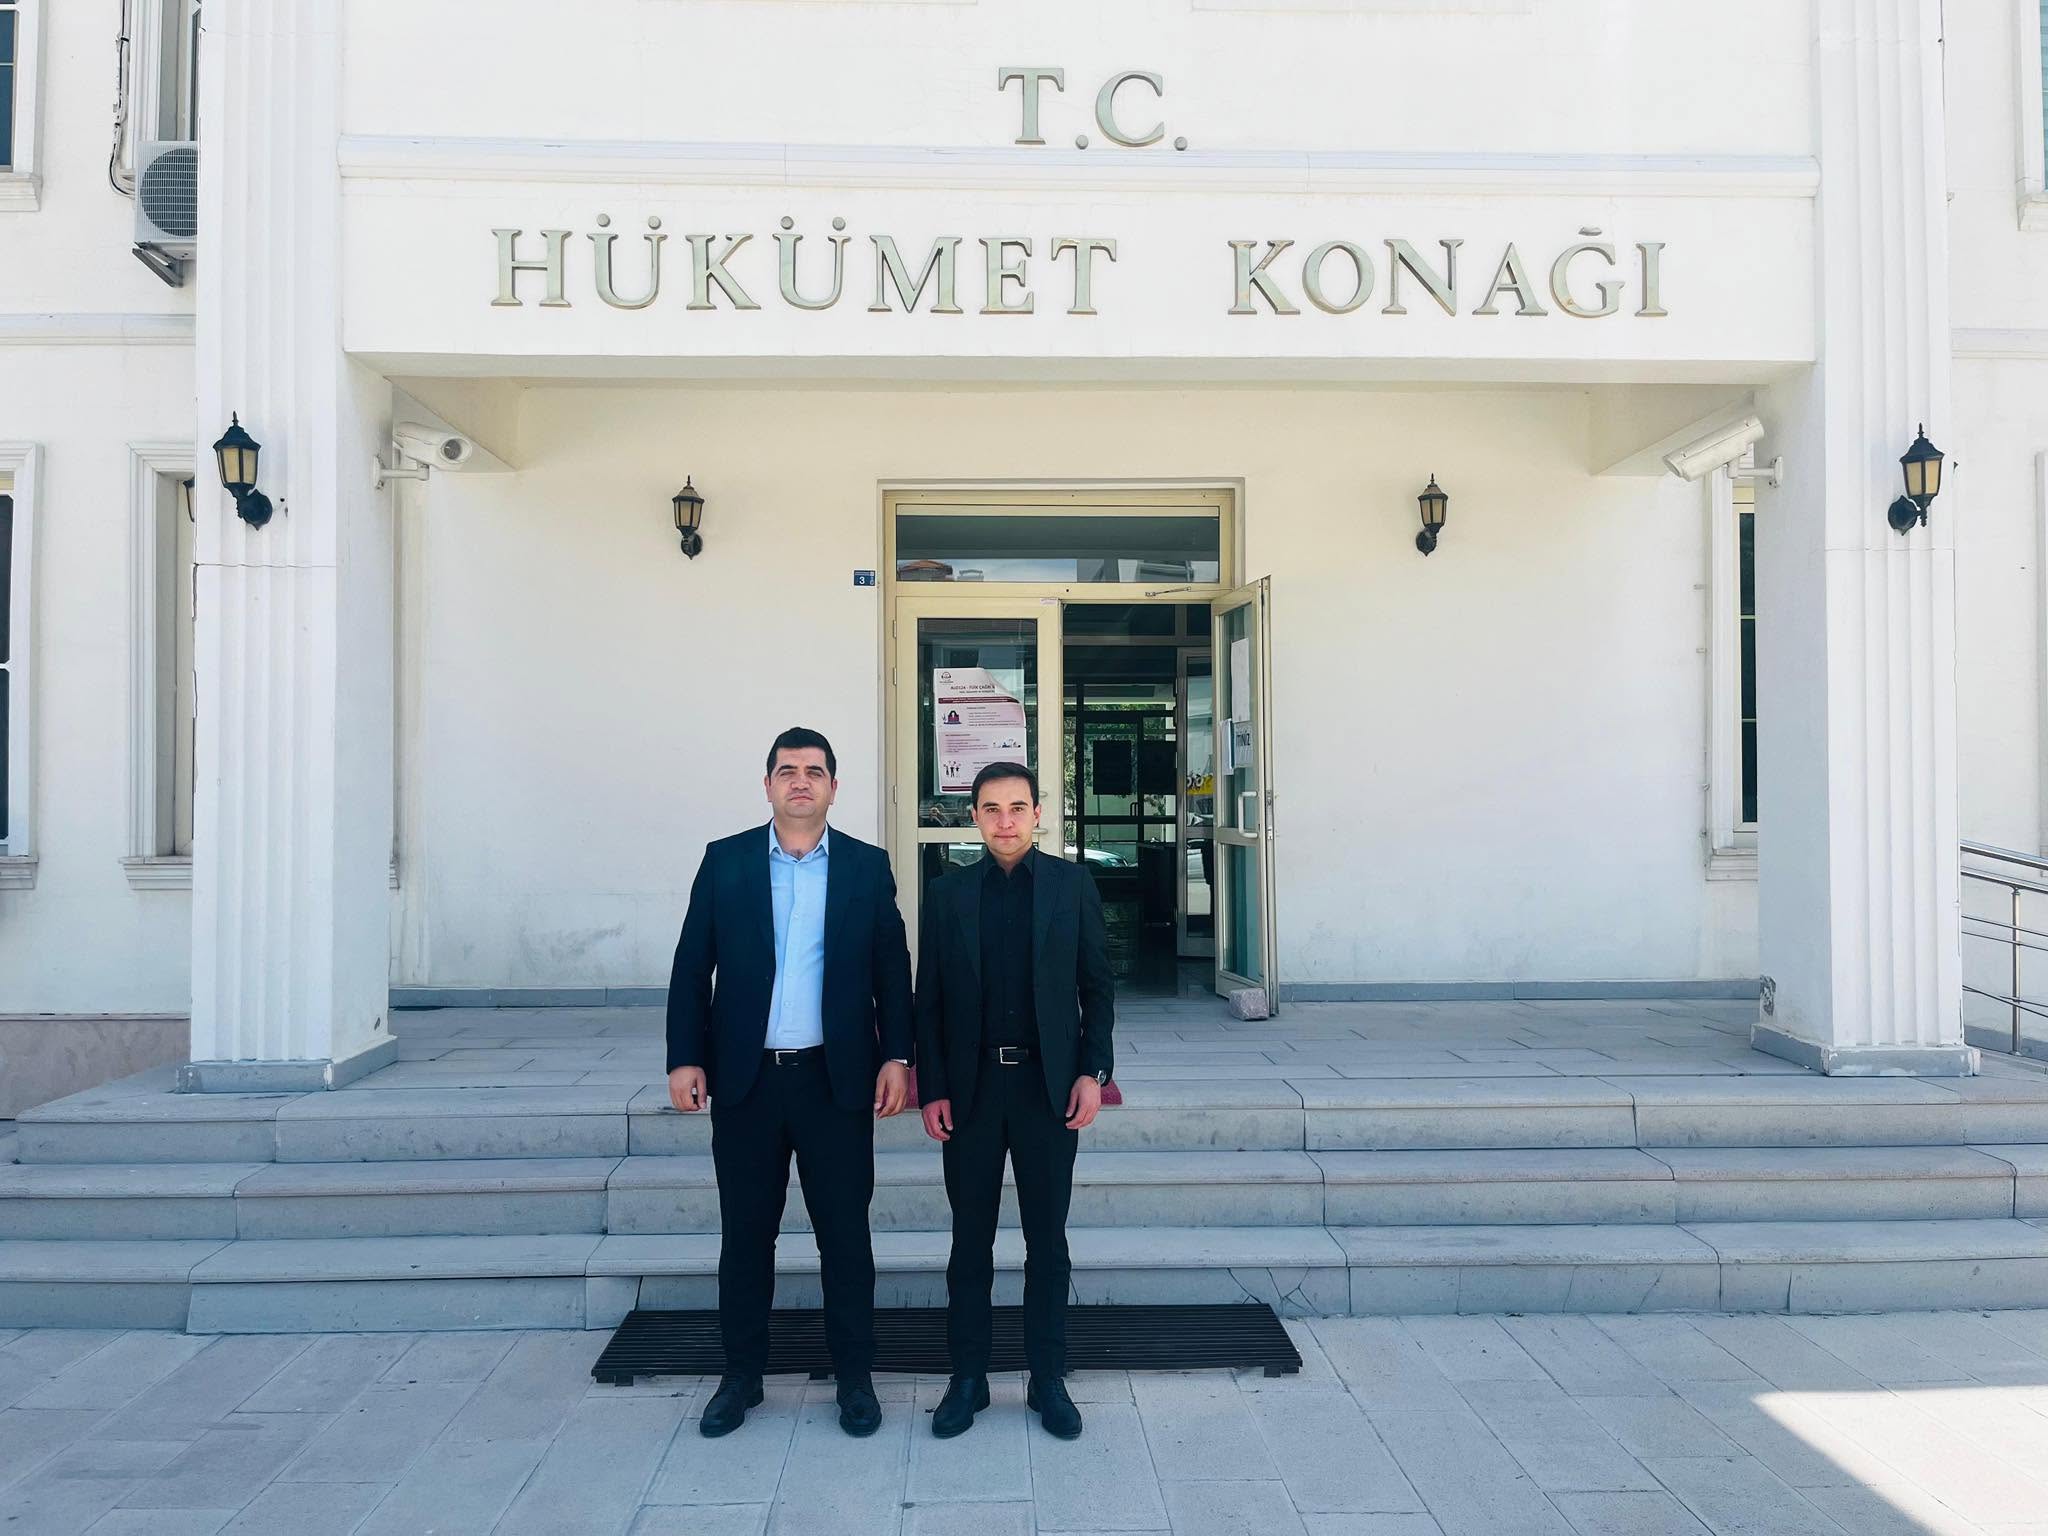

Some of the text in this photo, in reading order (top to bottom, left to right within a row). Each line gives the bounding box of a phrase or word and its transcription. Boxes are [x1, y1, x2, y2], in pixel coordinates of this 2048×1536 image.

[998, 66, 1188, 151] T.C.
[490, 213, 1669, 319] HÜKÜMET KONAĞI
[859, 576, 865, 585] 3
